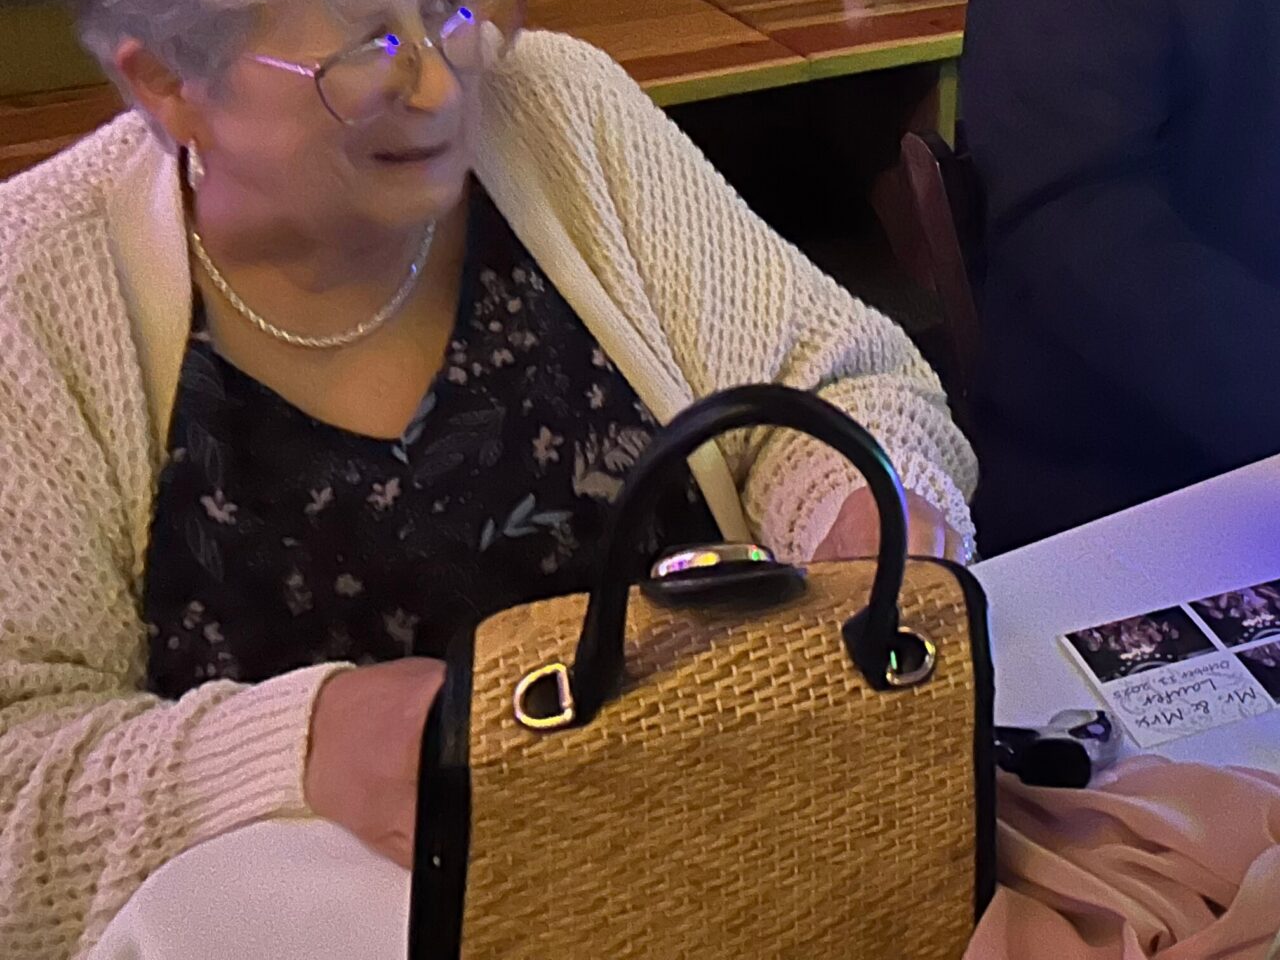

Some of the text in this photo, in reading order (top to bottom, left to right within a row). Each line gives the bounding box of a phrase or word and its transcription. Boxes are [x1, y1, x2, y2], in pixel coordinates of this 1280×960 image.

[1135, 687, 1257, 729] Mr. & Mrs.
[1143, 678, 1217, 706] Laufer
